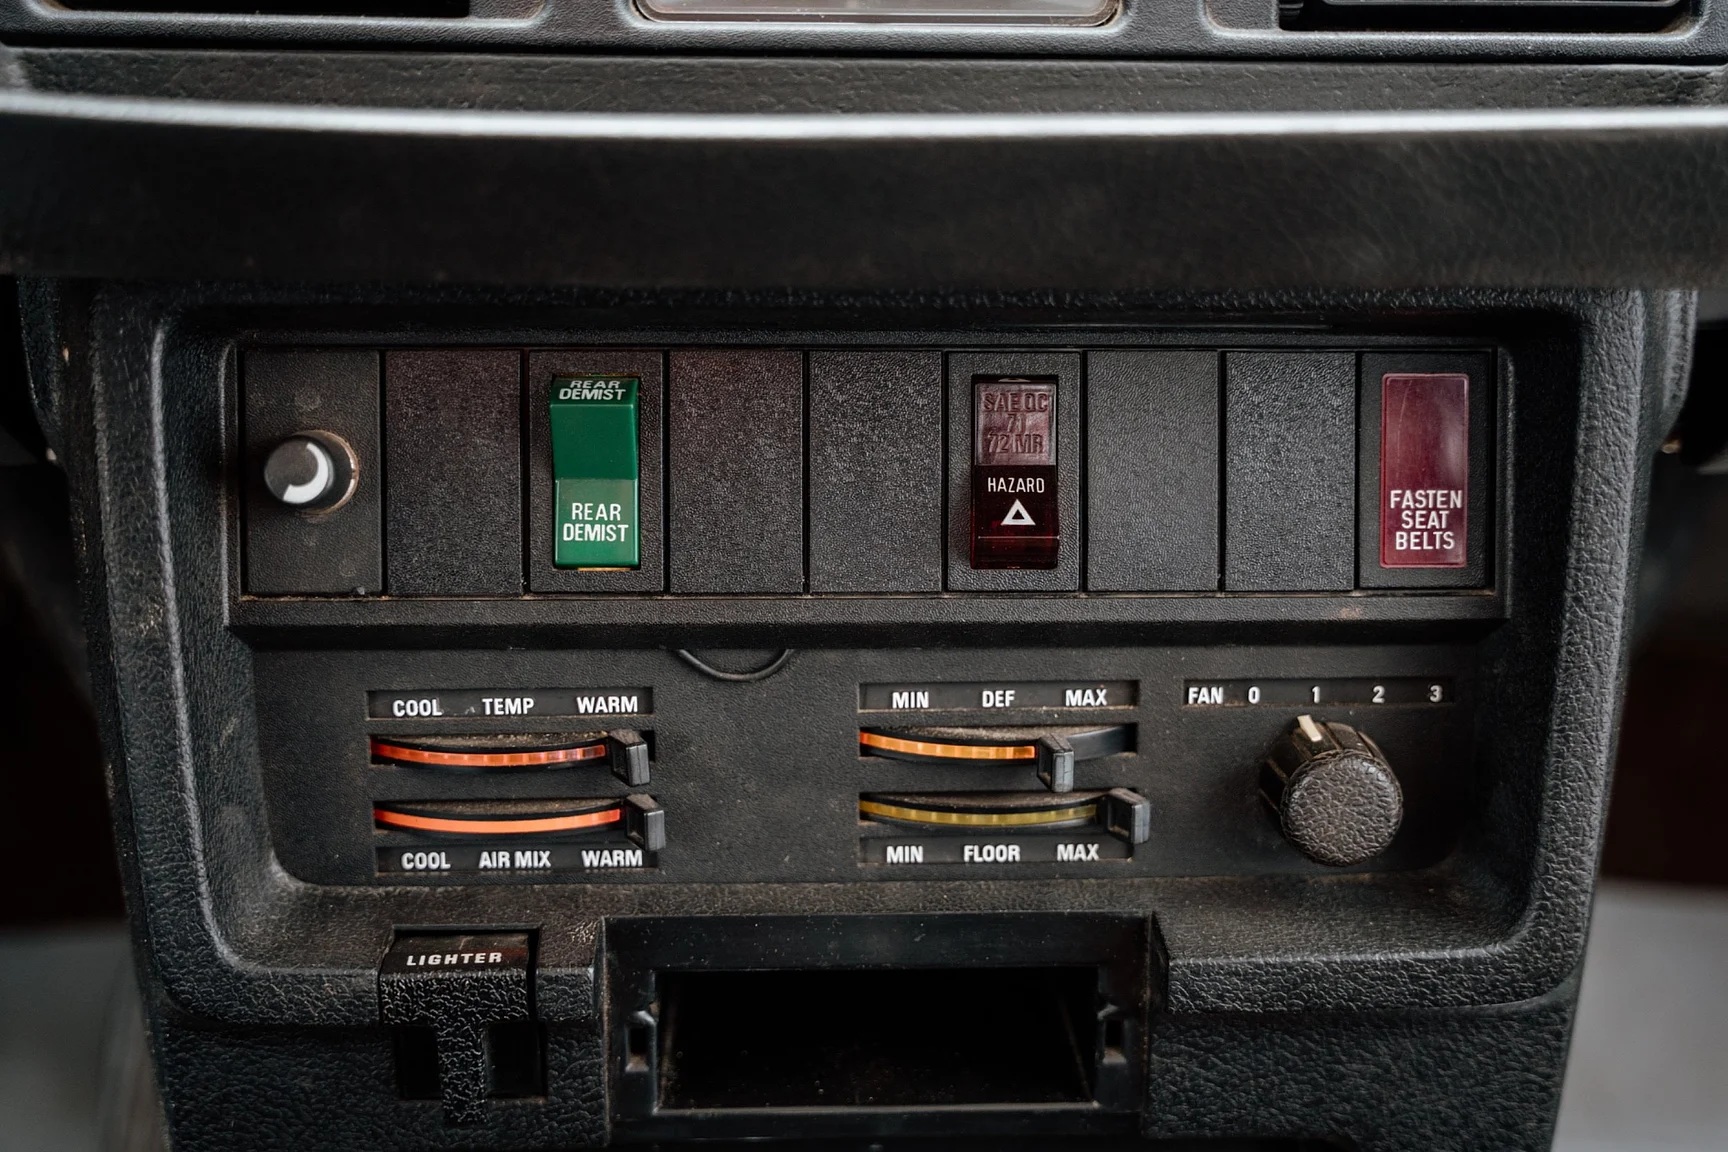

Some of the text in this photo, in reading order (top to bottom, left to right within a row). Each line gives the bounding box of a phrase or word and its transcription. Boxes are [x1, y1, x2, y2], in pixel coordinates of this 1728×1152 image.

[570, 380, 620, 389] REAR
[559, 388, 626, 400] DEMIST
[987, 477, 1045, 493] HAZARD
[1390, 490, 1462, 508] FASTEN
[572, 503, 621, 520] REAR
[1401, 511, 1449, 529] SEAT
[563, 524, 628, 541] DEMIST
[1396, 532, 1454, 550] BELTS
[892, 690, 1107, 708] MIN DEF MAX
[1188, 686, 1443, 704] FAN 0 1 2 3
[393, 696, 638, 717] COOL TEMP WARM
[401, 850, 643, 869] COOL AIR MIX WARM
[887, 844, 1099, 863] MIN FLOOR MAX
[407, 952, 502, 966] LIGHTER
